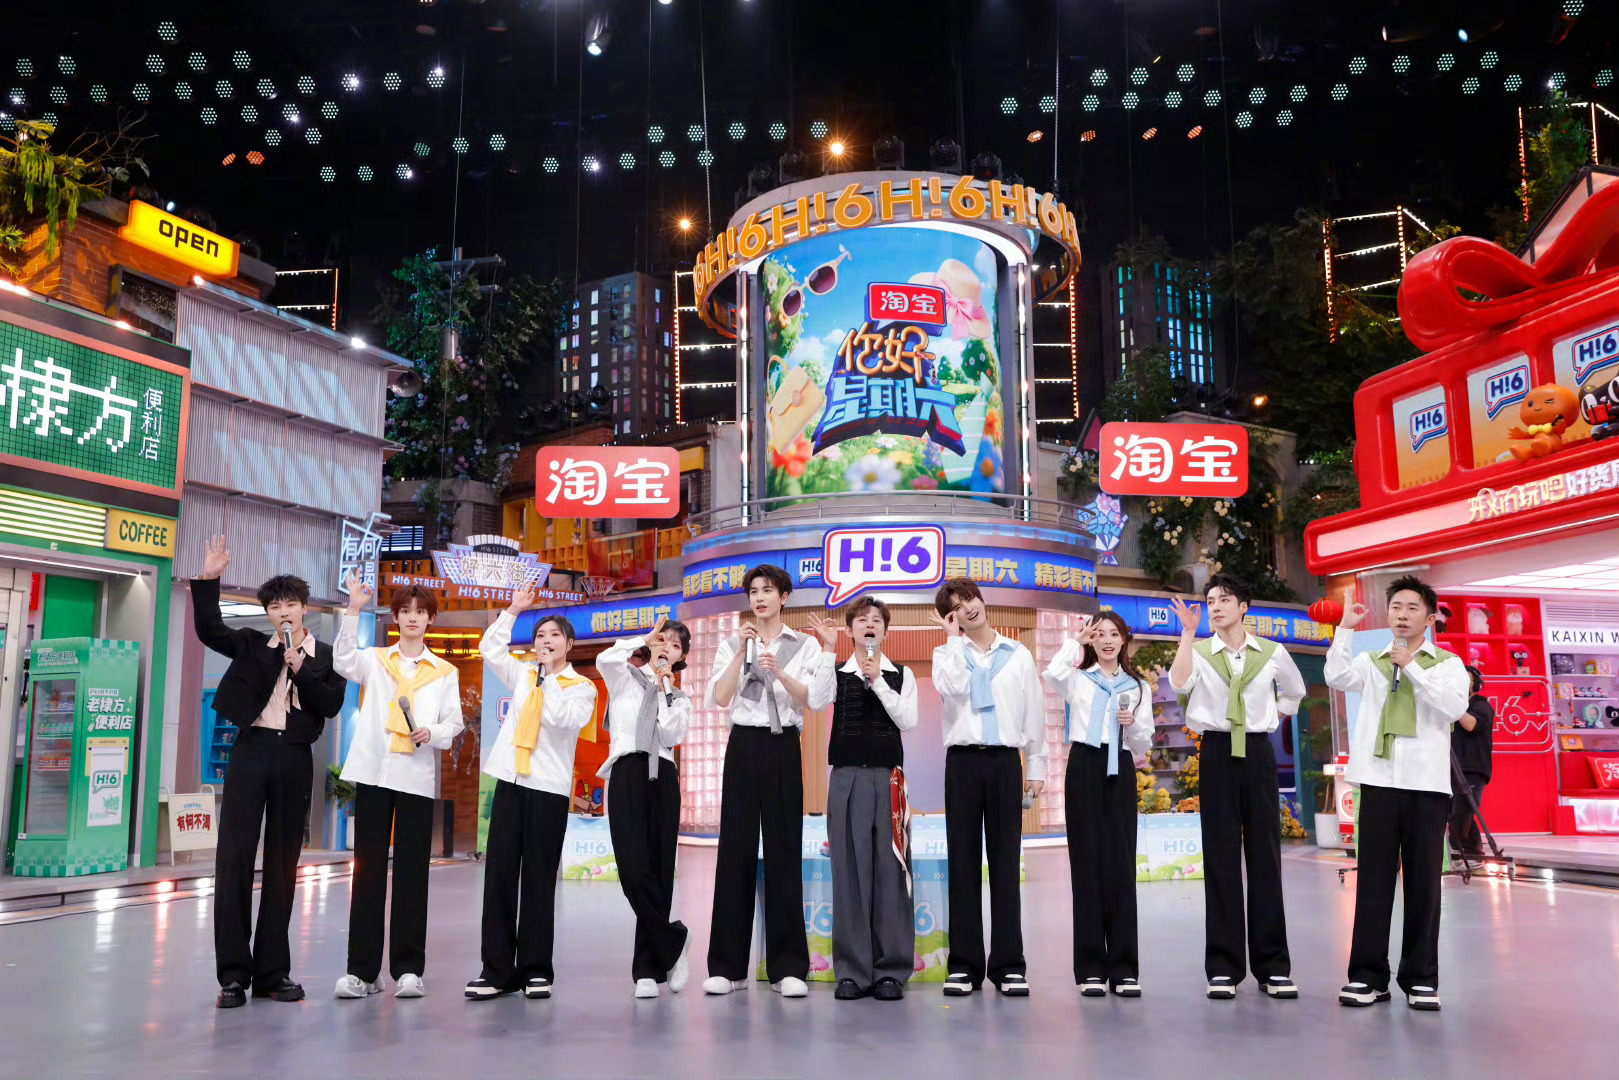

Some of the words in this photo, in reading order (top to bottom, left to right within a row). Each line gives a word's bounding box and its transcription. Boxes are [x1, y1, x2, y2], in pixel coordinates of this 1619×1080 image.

[158, 219, 219, 258] open
[880, 290, 937, 315] 淘宝
[1579, 334, 1618, 362] H!6
[1491, 372, 1523, 397] H!6
[0, 348, 138, 453] 棣方
[822, 375, 963, 437] 星期六
[139, 387, 163, 462] 便利店
[1415, 409, 1443, 431] H!6
[1110, 434, 1239, 483] 淘宝
[545, 457, 671, 506] 淘宝
[119, 519, 168, 547] COFFEE
[492, 547, 514, 555] STREET
[839, 536, 932, 574] H!6
[392, 575, 410, 586] H!6
[413, 577, 446, 588] STREET
[945, 557, 1019, 585] 星期六
[458, 586, 481, 599] H!6
[484, 589, 515, 601] STRE
[539, 590, 554, 599] H!6
[556, 592, 584, 602] STREET
[1151, 609, 1167, 620] H!6
[1551, 630, 1604, 643] KAIXIN
[95, 714, 134, 730] 便利店
[96, 774, 117, 785] H!6
[575, 839, 608, 856] H!6
[1163, 839, 1198, 853] H!6
